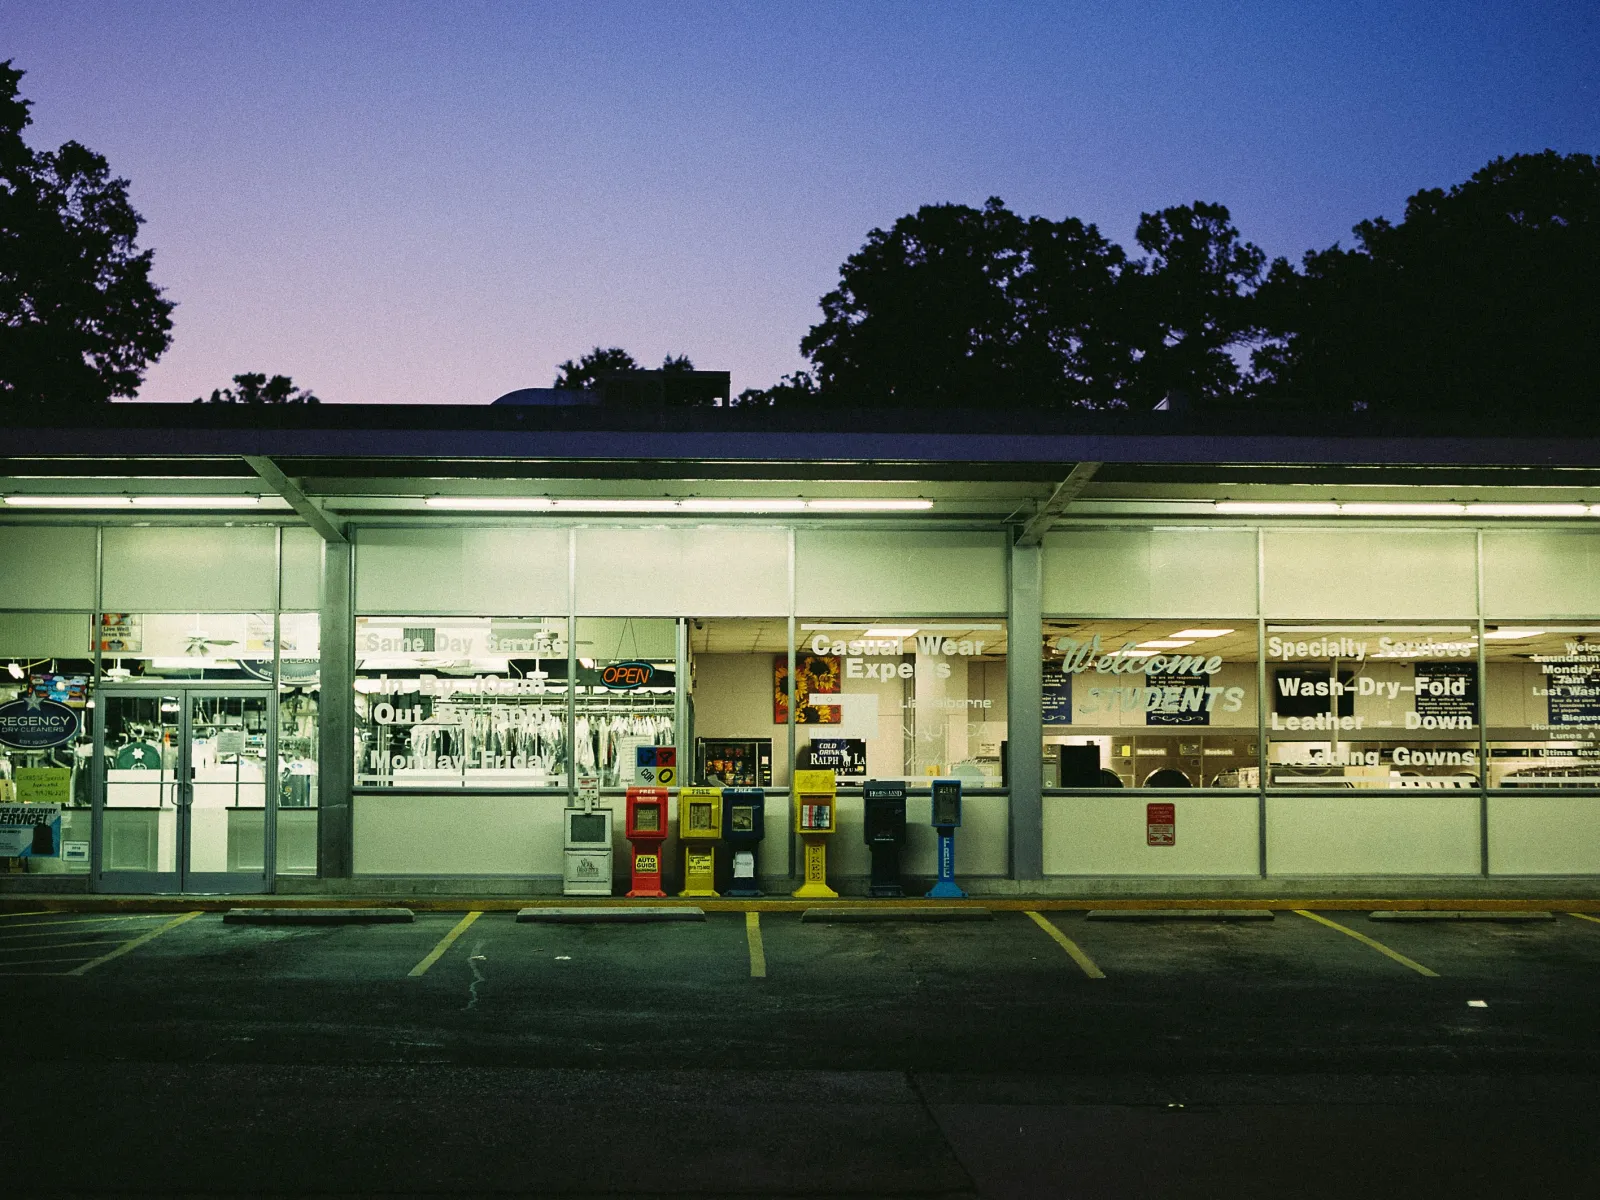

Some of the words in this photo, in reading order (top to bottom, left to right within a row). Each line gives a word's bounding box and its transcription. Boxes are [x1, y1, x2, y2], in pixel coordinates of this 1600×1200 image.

[367, 632, 425, 652] Same
[436, 633, 473, 655] Day
[487, 631, 563, 652] Service
[811, 634, 904, 656] Casual
[913, 635, 985, 656] Wear
[1268, 637, 1367, 661] Specialty
[1379, 637, 1471, 658] Services
[1056, 634, 1223, 675] Welcome
[603, 666, 650, 684] OPEN
[846, 657, 951, 683] Expes
[1556, 676, 1585, 684] 7am
[379, 673, 405, 696] In
[419, 673, 455, 702] By
[475, 674, 545, 695] 10am
[1532, 687, 1562, 696] Last
[1078, 686, 1245, 715] STUDENTS
[0, 716, 70, 726] REGENCY
[374, 702, 423, 726] Out
[439, 704, 476, 732] By
[1271, 712, 1364, 730] Leather
[1405, 712, 1473, 730] Down
[901, 723, 989, 737] NAUTCA
[370, 750, 554, 773] Monday-Friday
[810, 753, 839, 765] RALPH
[1392, 747, 1476, 766] Gowns
[640, 768, 654, 782] COR
